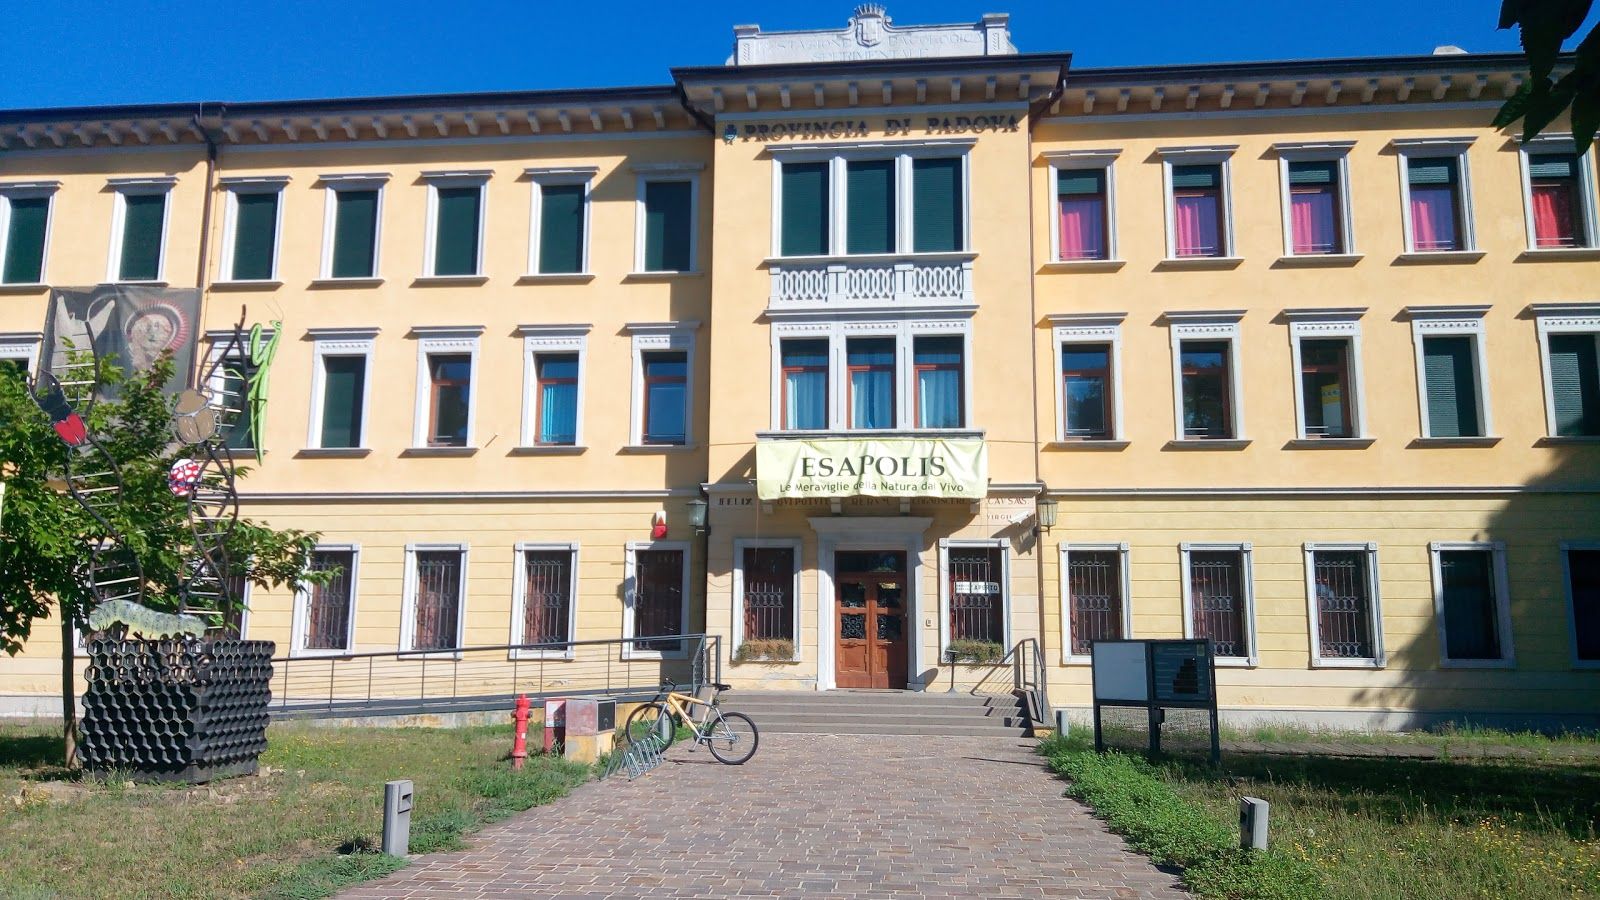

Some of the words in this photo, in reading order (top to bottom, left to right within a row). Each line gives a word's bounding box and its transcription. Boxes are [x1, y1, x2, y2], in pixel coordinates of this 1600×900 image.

[743, 120, 869, 142] PROVINCIA
[884, 118, 911, 137] DI
[926, 114, 1019, 135] PADOVA
[801, 455, 945, 477] ESAPOLIS
[780, 483, 791, 493] Le
[795, 481, 850, 493] Meraviglie
[853, 481, 877, 490] della
[881, 482, 918, 491] Natura
[940, 482, 964, 492] Vivo
